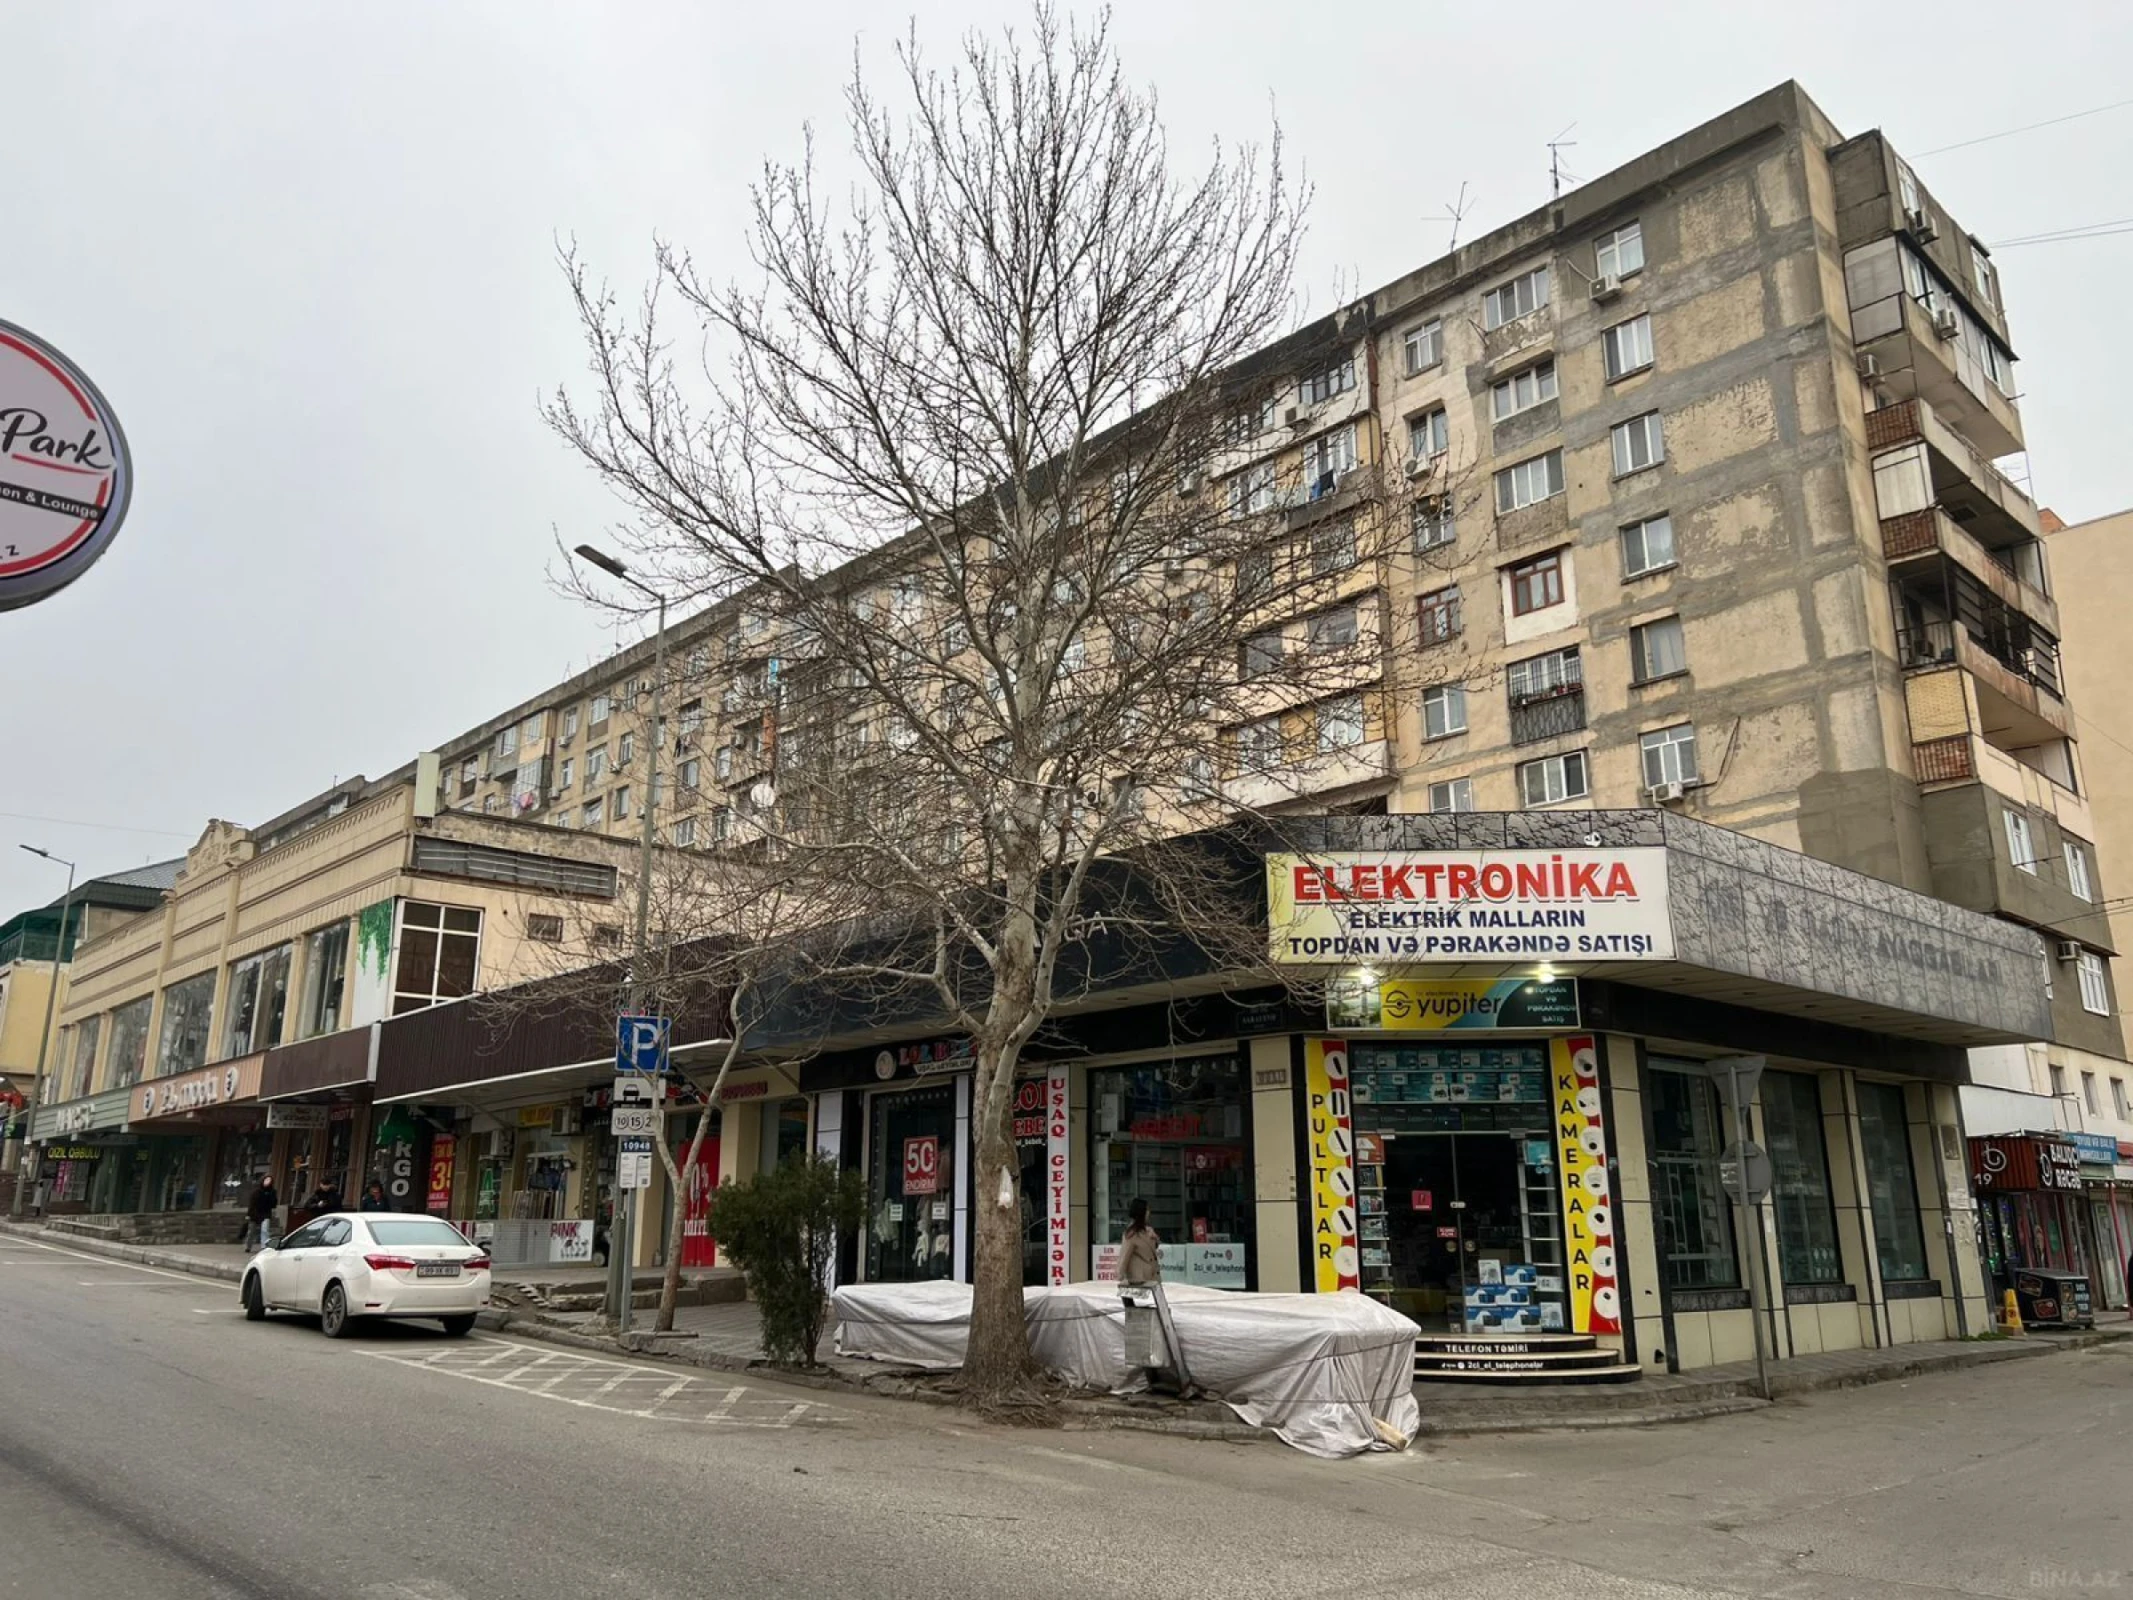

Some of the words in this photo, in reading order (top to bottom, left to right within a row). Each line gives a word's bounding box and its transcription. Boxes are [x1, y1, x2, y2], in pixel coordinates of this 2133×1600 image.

[0, 407, 112, 470] Park
[25, 491, 37, 503] &
[41, 494, 99, 519] Lounge
[1293, 854, 1640, 904] ELEKTRONİKA
[1350, 907, 1461, 929] ELEKTRİK
[1469, 909, 1586, 928] MALLARIN
[1288, 936, 1380, 956] TOPDAN
[1387, 936, 1419, 955] VƏ
[1425, 935, 1571, 955] PƏRAKƏNDƏ
[1578, 933, 1652, 957] SATIŞI
[1416, 992, 1501, 1018] yupiter
[631, 1022, 660, 1065] P
[1051, 1077, 1066, 1138] UŞAQ
[617, 1116, 627, 1126] 10
[630, 1116, 642, 1127] 15
[623, 1141, 651, 1150] 10948
[1312, 1094, 1332, 1260] PULTLAR
[1558, 1074, 1590, 1291] KAMERALAR
[1974, 1172, 1993, 1186] 19
[550, 1222, 580, 1239] PINK
[1445, 1343, 1492, 1353] TELEFON
[1494, 1343, 1529, 1353] TƏMİRİ
